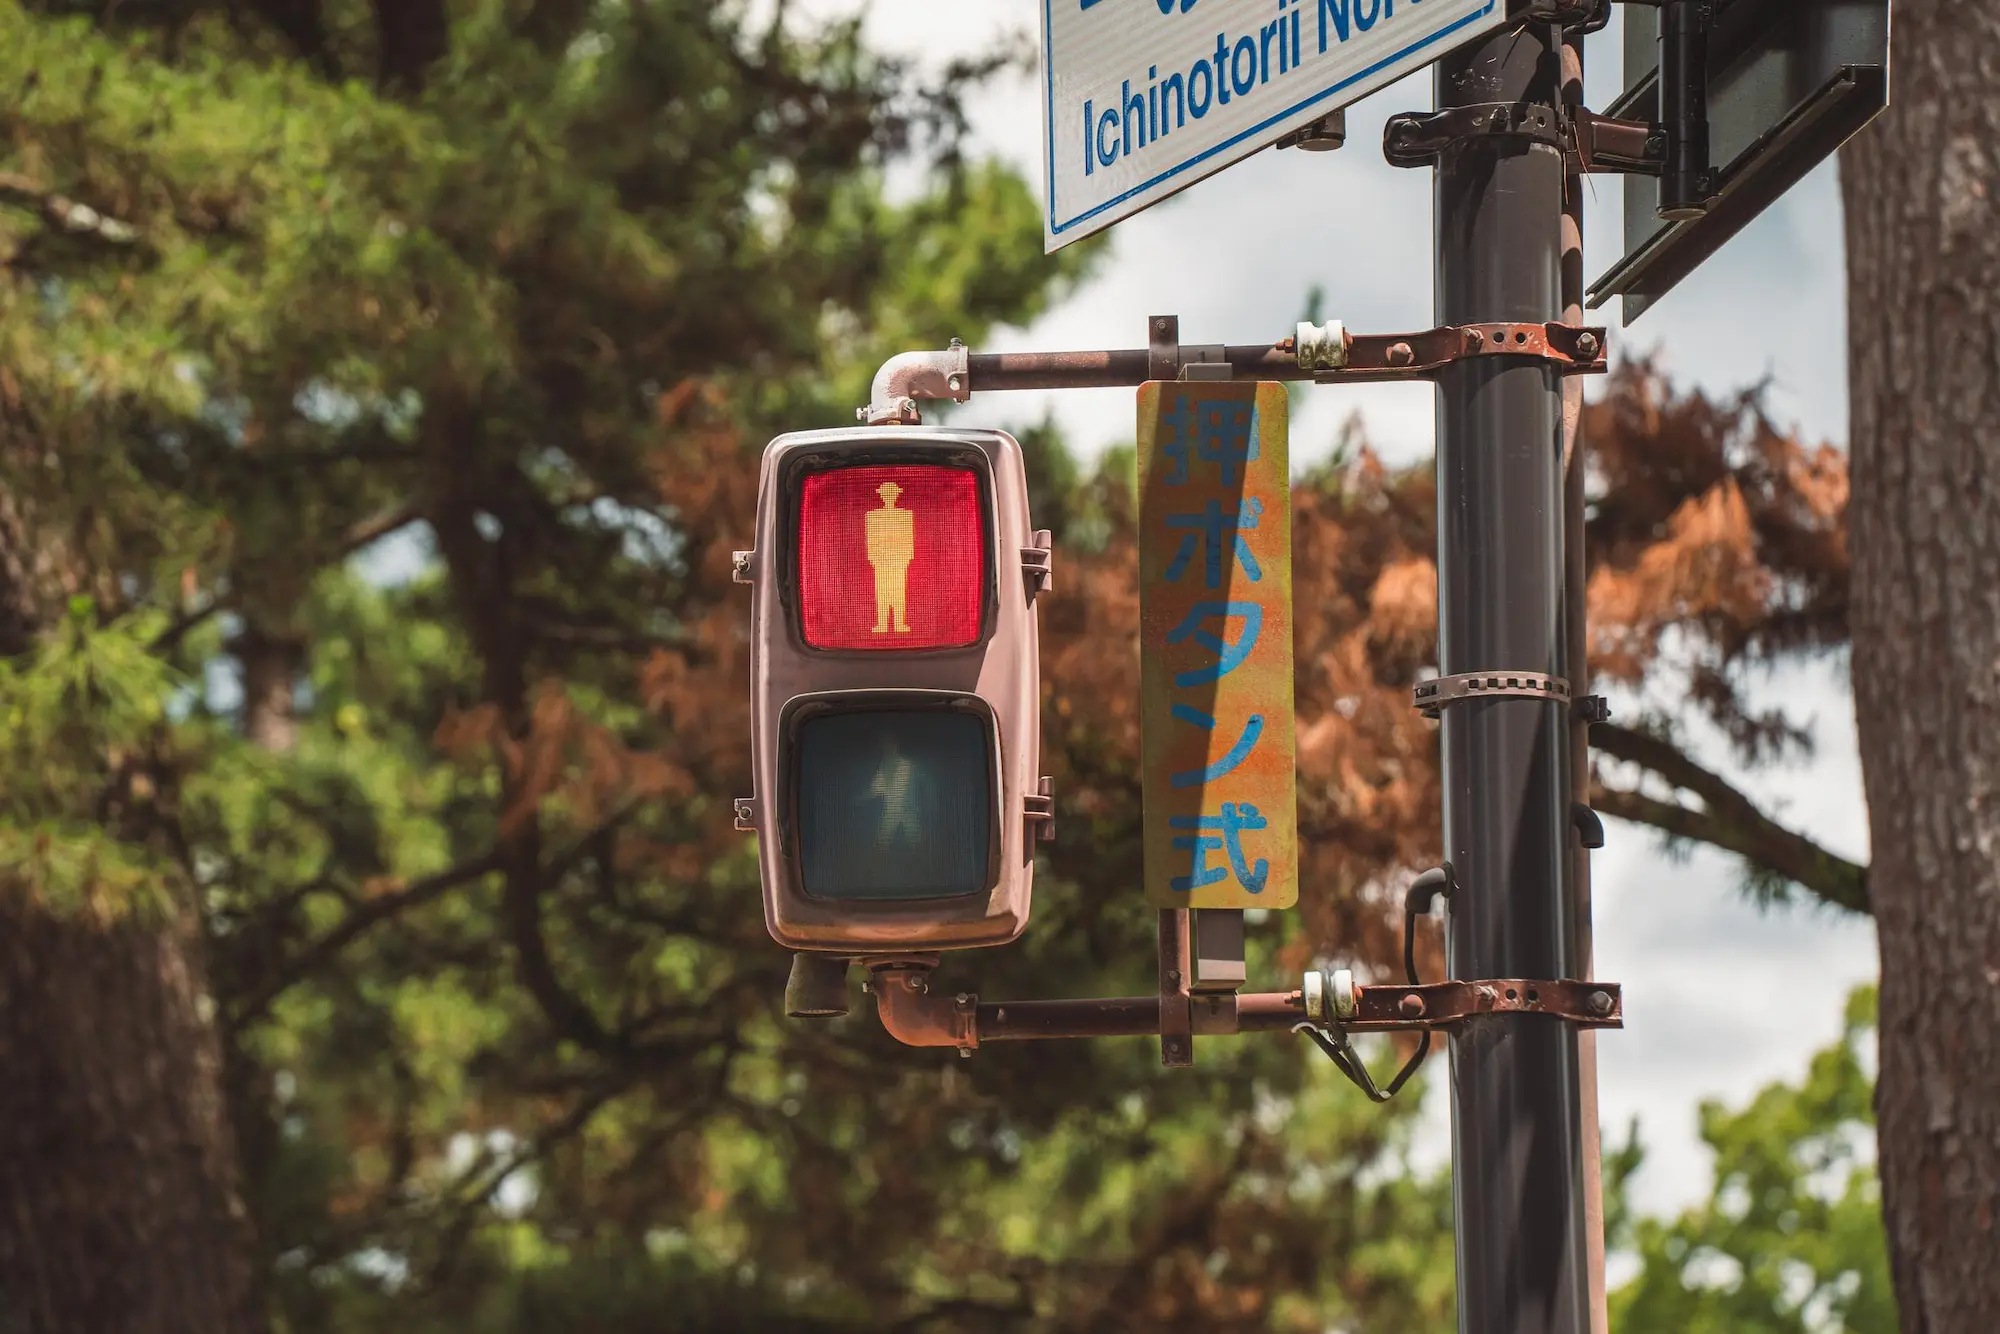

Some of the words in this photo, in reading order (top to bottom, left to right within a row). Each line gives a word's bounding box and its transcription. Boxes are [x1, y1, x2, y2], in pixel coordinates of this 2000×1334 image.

[1084, 0, 1300, 176] Ichinotorii
[1163, 395, 1268, 893] 押ボタン式
